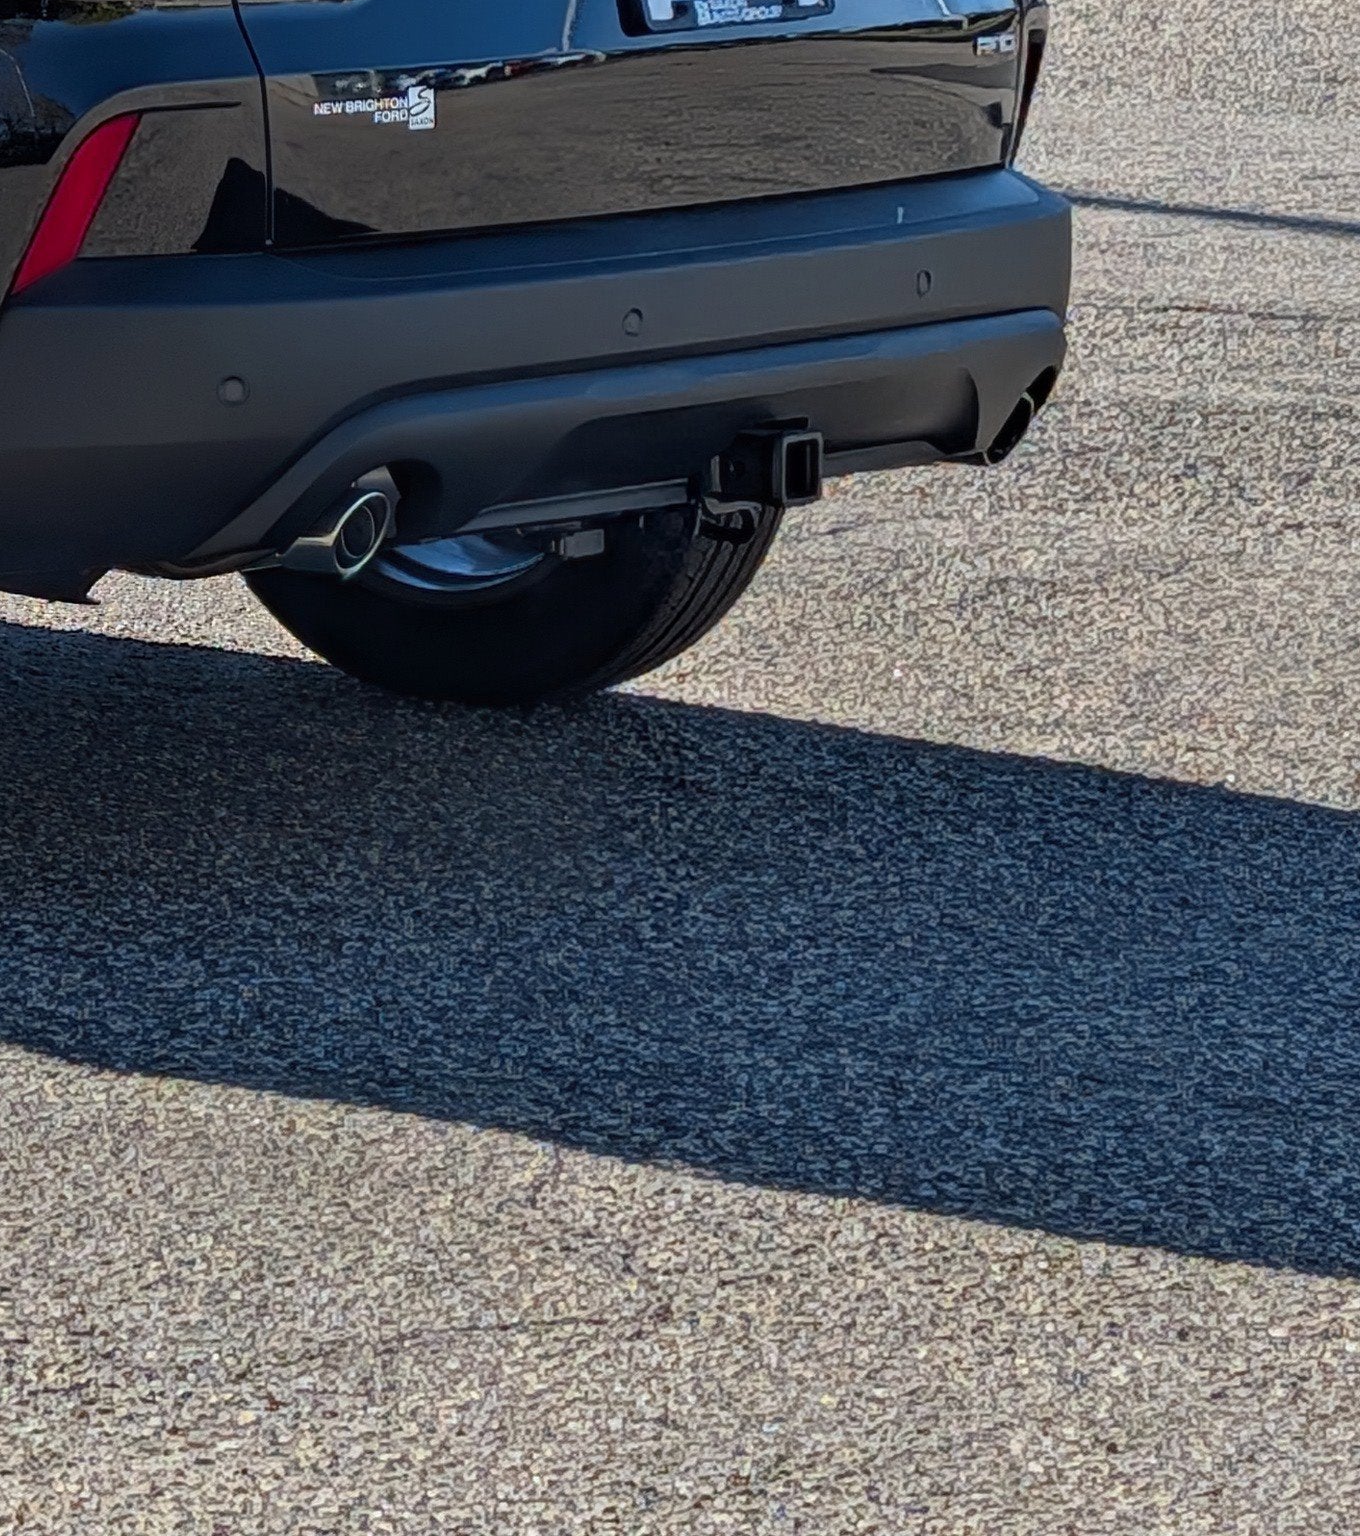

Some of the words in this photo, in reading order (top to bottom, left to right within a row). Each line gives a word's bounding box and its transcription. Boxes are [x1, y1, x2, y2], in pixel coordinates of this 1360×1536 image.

[313, 102, 343, 116] NEW
[345, 96, 409, 115] BRIGHTON
[374, 109, 409, 124] FORD
